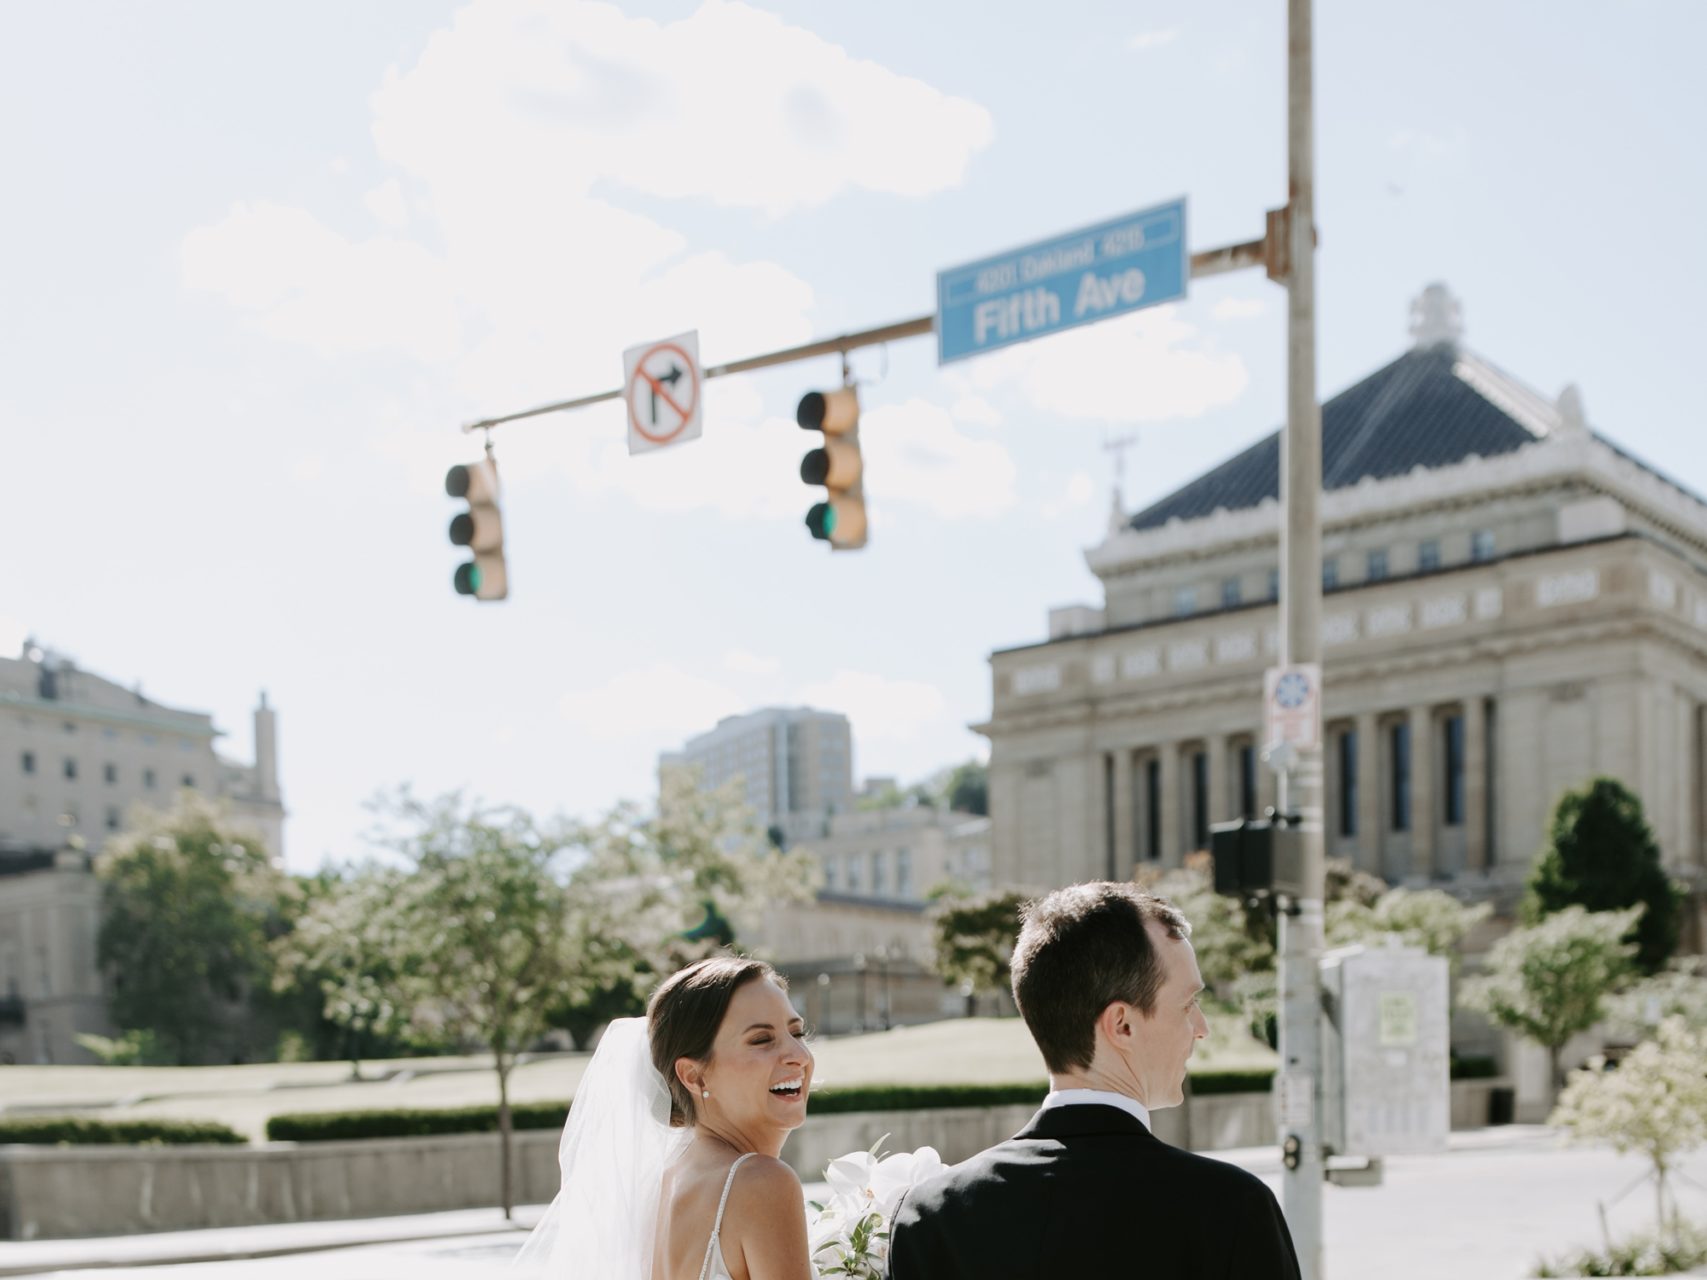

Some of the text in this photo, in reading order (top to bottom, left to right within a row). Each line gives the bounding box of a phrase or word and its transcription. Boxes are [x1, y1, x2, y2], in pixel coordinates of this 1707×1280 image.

[1021, 239, 1095, 281] Oakland
[973, 267, 1146, 344] Fifth Ave
